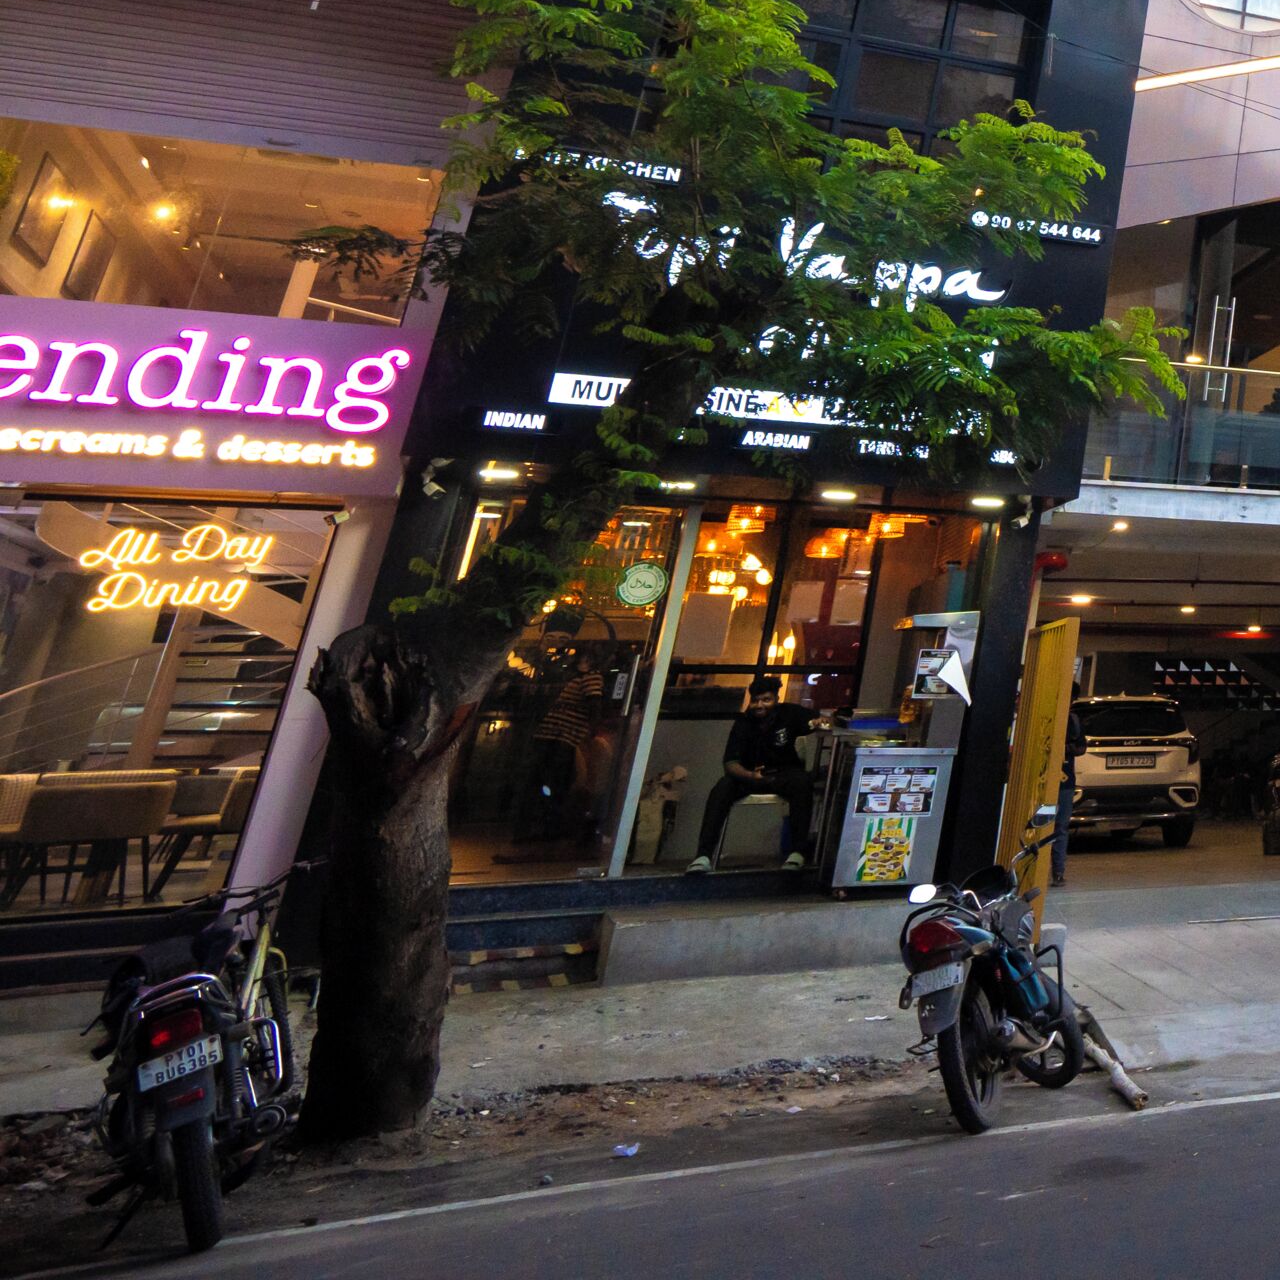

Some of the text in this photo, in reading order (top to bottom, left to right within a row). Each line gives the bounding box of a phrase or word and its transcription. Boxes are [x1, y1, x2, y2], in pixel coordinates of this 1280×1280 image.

[1072, 227, 1101, 242] 644
[484, 410, 546, 431] INDIAN
[172, 428, 204, 460] &
[217, 434, 376, 468] desserts
[741, 430, 811, 450] ARABIAN
[79, 524, 277, 570] All Day
[86, 570, 249, 613] Dining
[154, 1050, 218, 1083] BU6385
[164, 1042, 204, 1067] PY01
